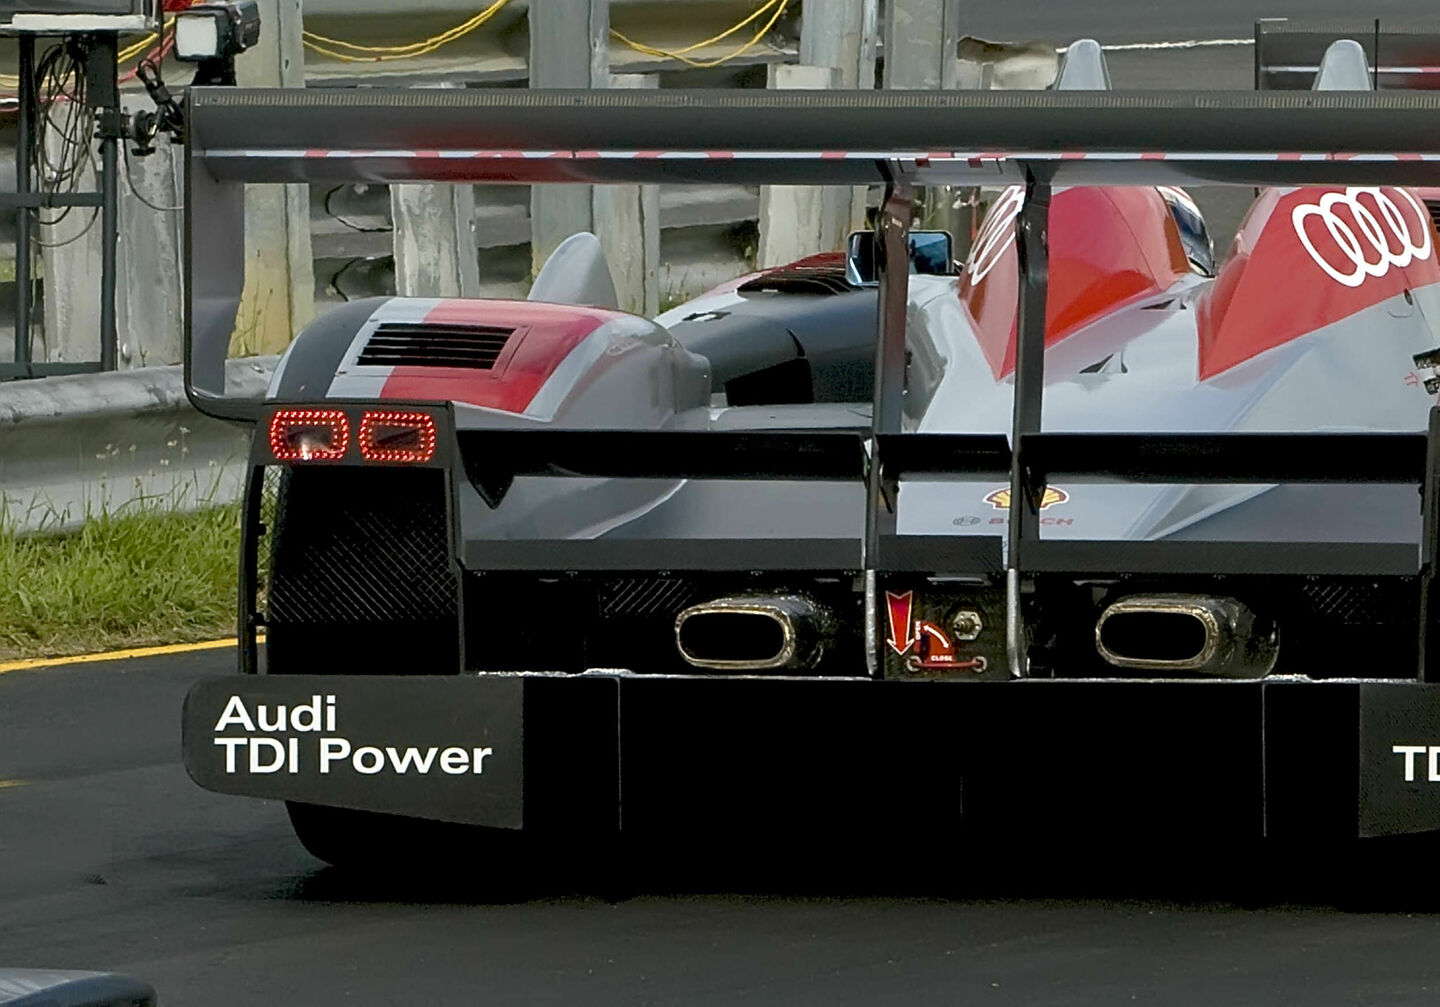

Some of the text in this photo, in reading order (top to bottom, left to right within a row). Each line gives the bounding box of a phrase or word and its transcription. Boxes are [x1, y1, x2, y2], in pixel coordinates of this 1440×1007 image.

[214, 695, 336, 731] Audi
[214, 738, 492, 774] TDI Power
